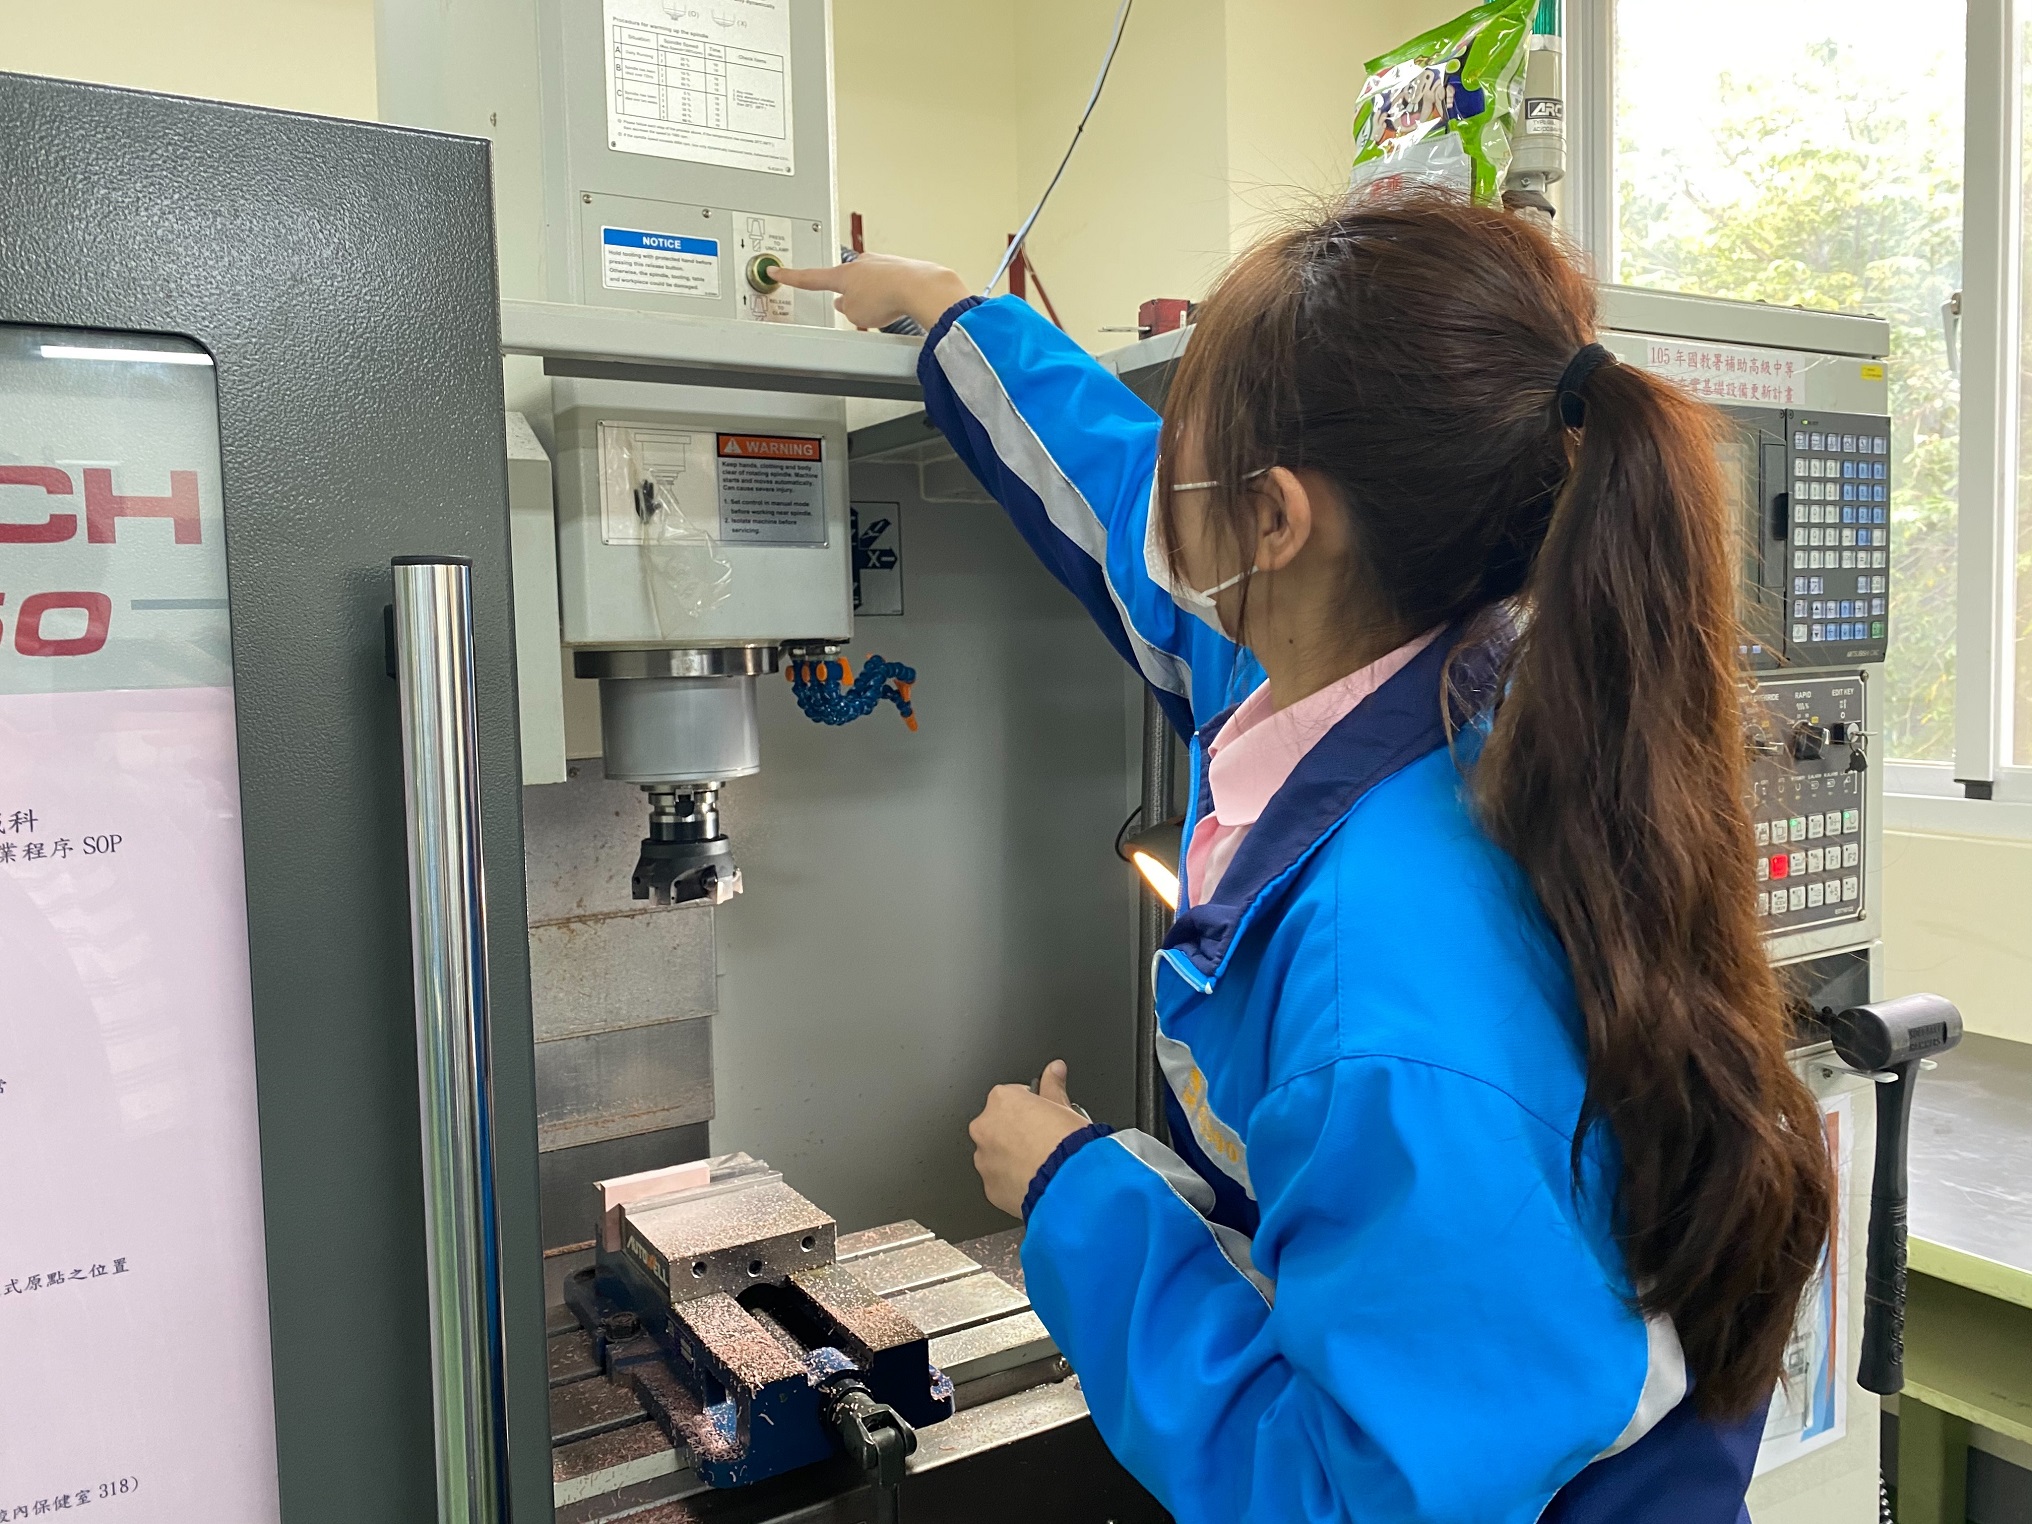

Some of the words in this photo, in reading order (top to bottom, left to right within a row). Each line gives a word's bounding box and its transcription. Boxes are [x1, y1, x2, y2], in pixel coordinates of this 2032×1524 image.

[642, 236, 682, 249] NOTICE
[609, 259, 632, 267] pressing
[1651, 346, 1670, 365] 105
[745, 441, 814, 457] WARNING
[760, 463, 784, 471] clothing
[0, 591, 112, 657] 0
[1795, 691, 1812, 699] RAPID
[1844, 688, 1854, 696] KEY
[0, 808, 38, 834] 科
[83, 834, 122, 854] SOP
[1830, 856, 1839, 865] F1
[1847, 852, 1857, 862] F2
[4, 1257, 129, 1295] 式原點之位置
[99, 1476, 138, 1499] 318)
